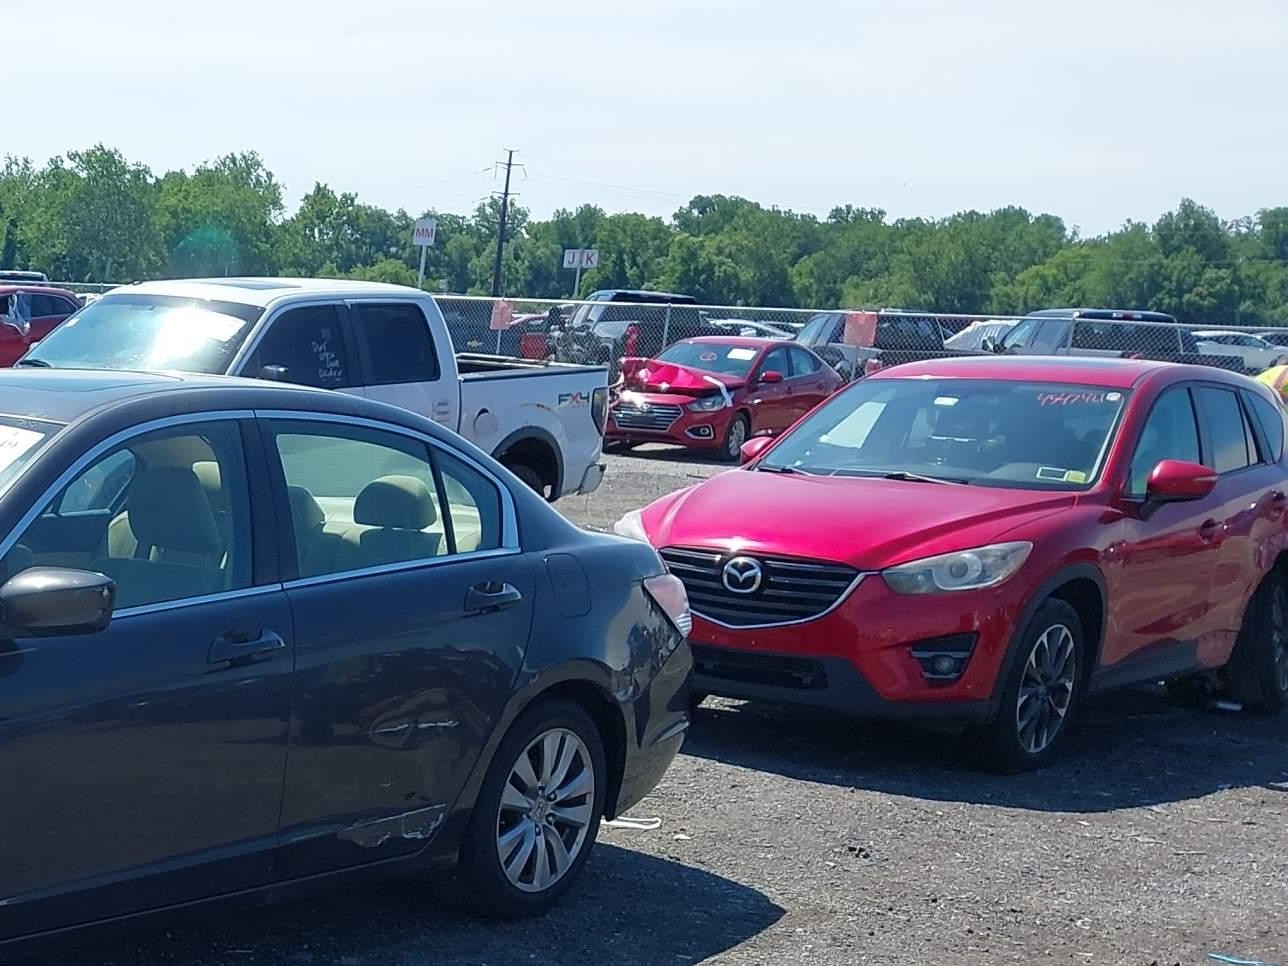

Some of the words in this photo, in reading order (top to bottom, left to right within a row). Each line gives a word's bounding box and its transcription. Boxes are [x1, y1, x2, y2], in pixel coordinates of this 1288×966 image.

[415, 227, 434, 239] MM
[567, 252, 576, 265] J
[585, 252, 595, 265] K
[557, 391, 590, 406] FX4
